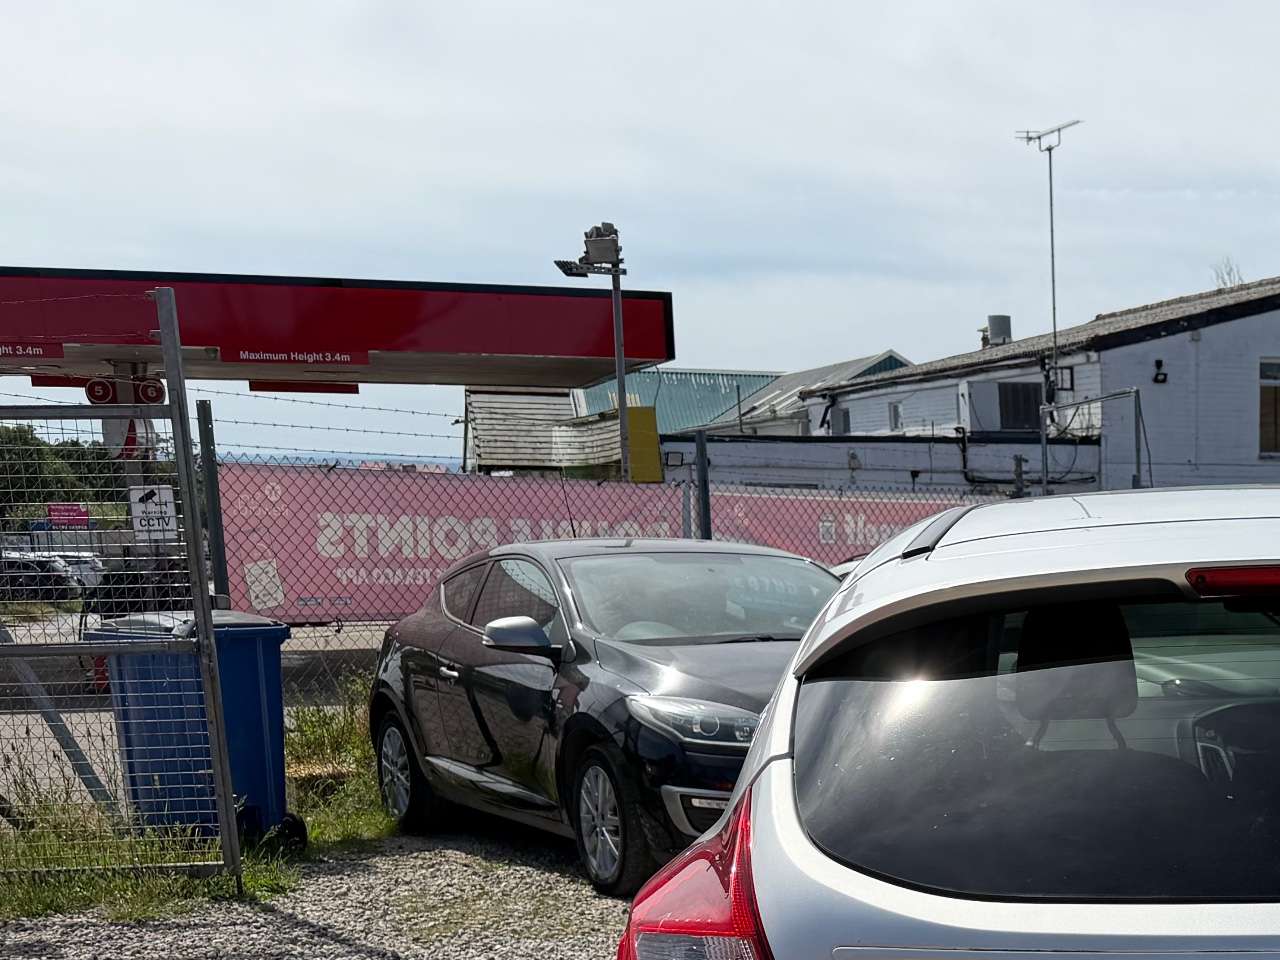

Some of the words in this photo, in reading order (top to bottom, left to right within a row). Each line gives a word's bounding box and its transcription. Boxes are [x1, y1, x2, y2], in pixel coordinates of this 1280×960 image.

[15, 345, 43, 355] 3.4m
[240, 351, 288, 361] Maximum
[290, 352, 323, 363] Height
[324, 353, 351, 362] 3.4m
[95, 386, 103, 396] 5
[147, 387, 156, 398] 6
[139, 516, 171, 528] CCTV
